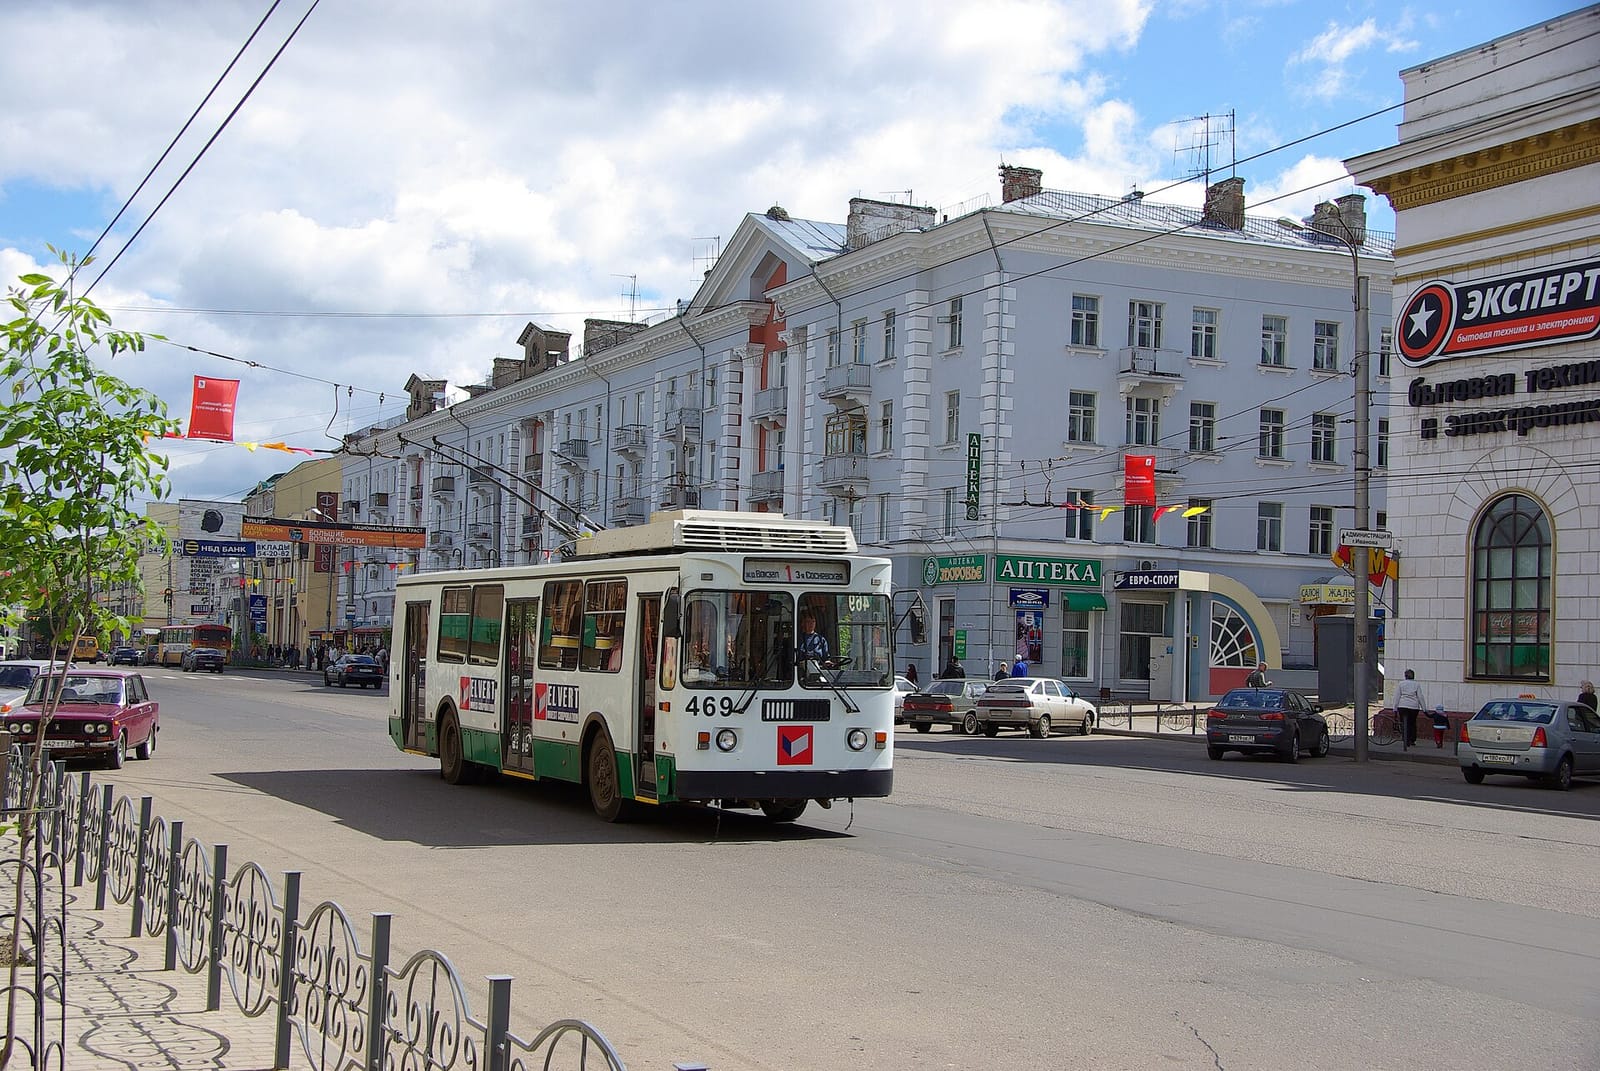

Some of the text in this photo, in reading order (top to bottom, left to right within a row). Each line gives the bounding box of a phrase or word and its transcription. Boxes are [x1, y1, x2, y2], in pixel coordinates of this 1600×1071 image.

[1461, 268, 1600, 322] ЭКСПЕРТ
[1457, 315, 1595, 343] бытовая техника и электроника
[1408, 373, 1516, 407] бытовая
[1420, 417, 1438, 439] и
[969, 435, 979, 503] АПТЕКА
[308, 535, 365, 545] ВОЗМОЖНОСТИ
[309, 529, 345, 538] БОЛЬШИЕ
[1345, 530, 1391, 540] АДМИНИСТРАЦИЯ
[201, 544, 246, 554] НБД БАНК
[256, 544, 290, 552] ВКЛАДЫ
[947, 557, 976, 566] АПТЕКА
[1000, 559, 1097, 582] АПТЕКА
[785, 564, 792, 582] 1
[939, 565, 983, 582] ЗДОРОВЬЕ
[1129, 574, 1178, 585] ЕВРО-СПОРТ
[1301, 588, 1320, 598] САЛОН
[471, 679, 496, 700] ELVERT
[547, 685, 579, 709] ELVERT
[685, 695, 734, 717] 469
